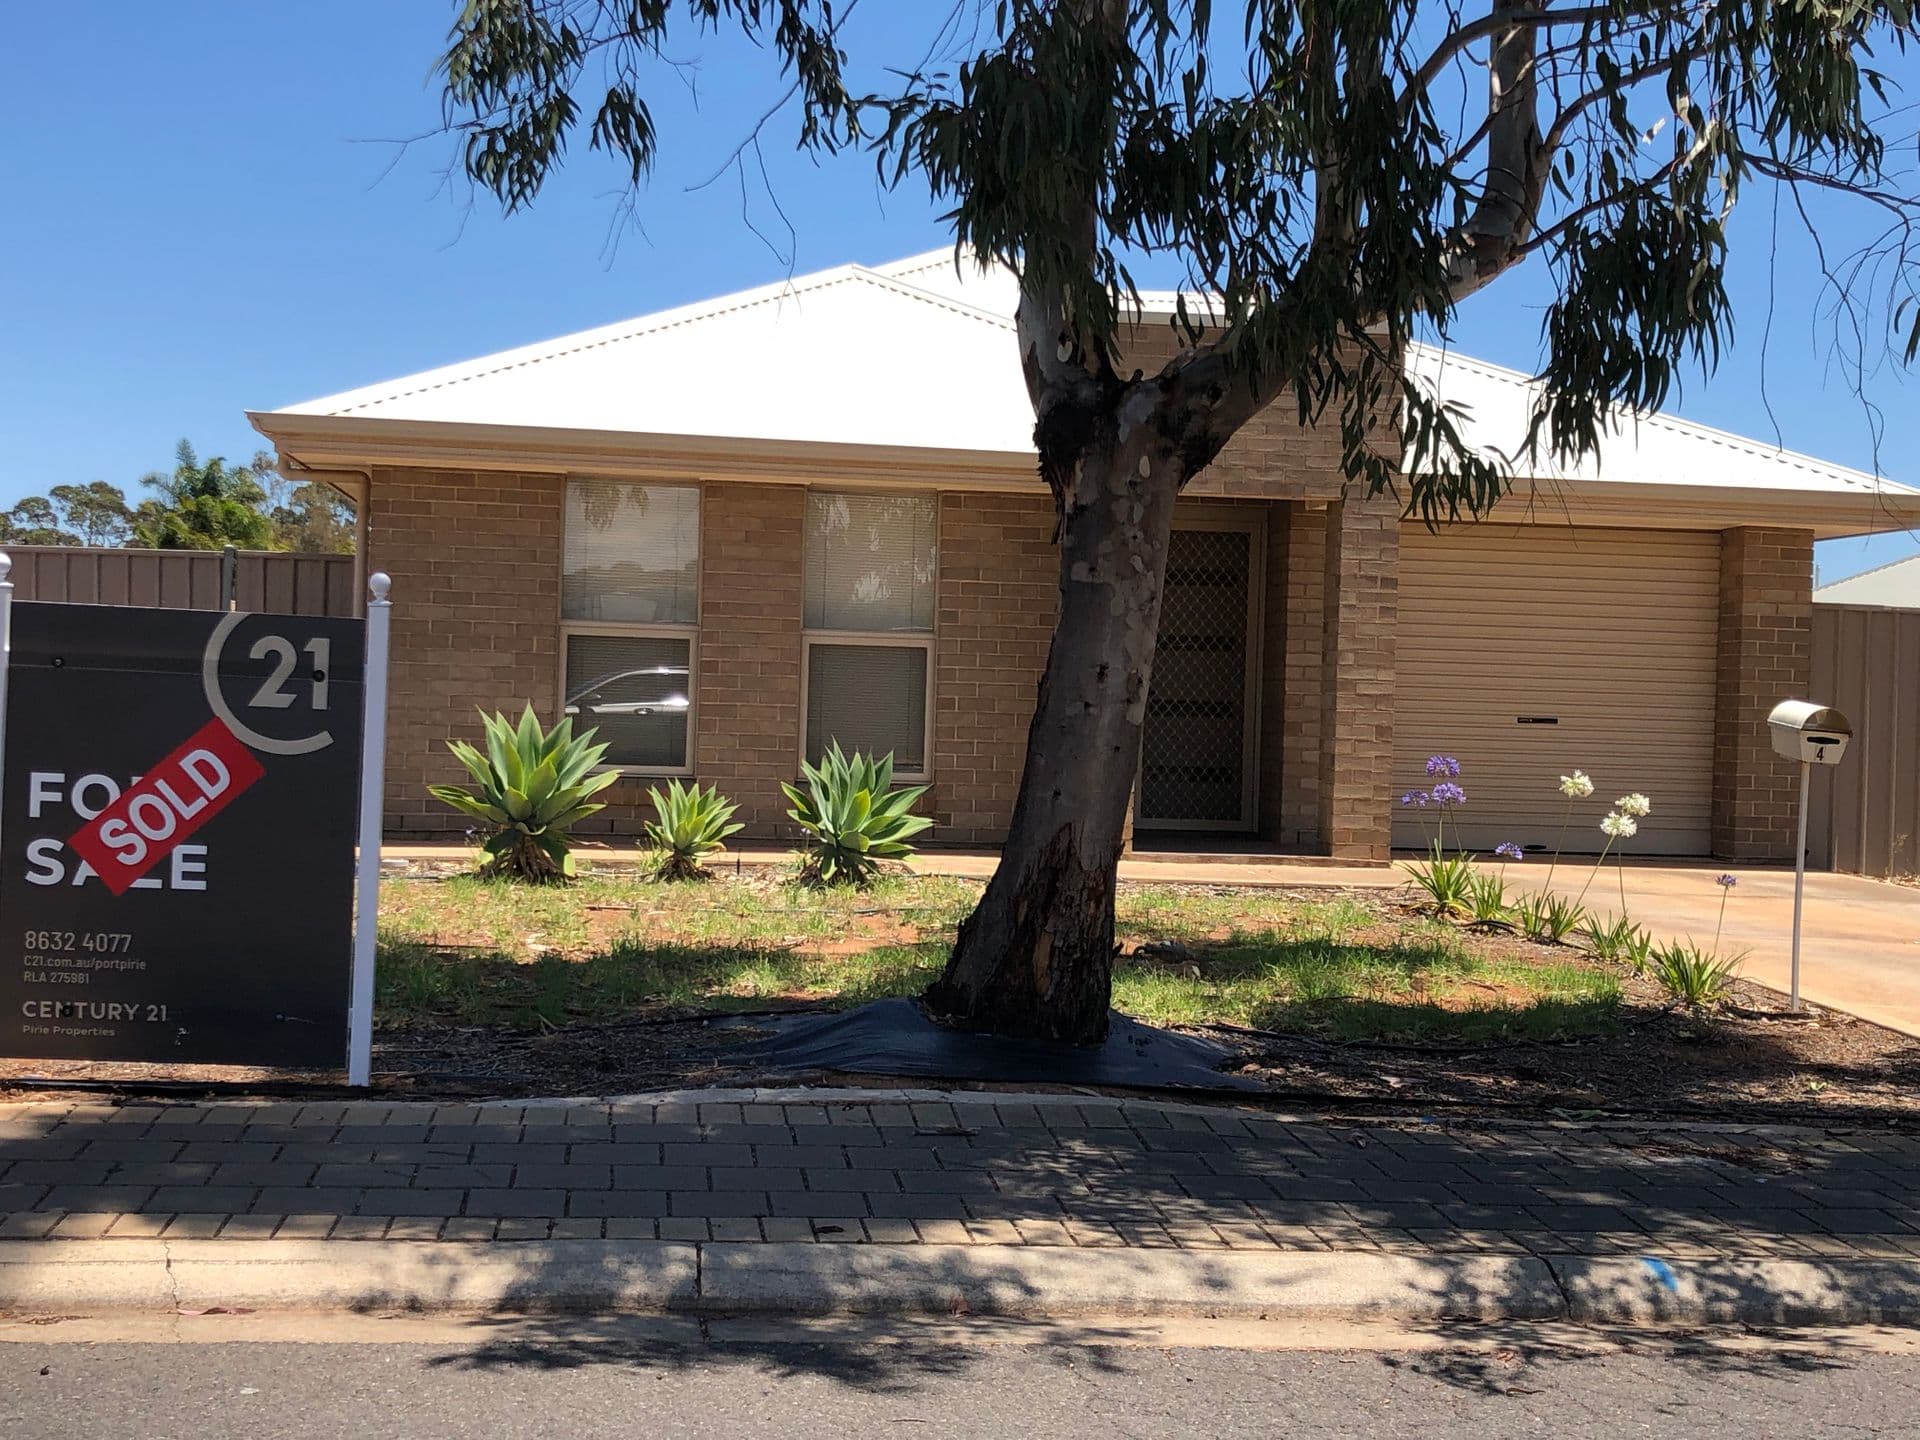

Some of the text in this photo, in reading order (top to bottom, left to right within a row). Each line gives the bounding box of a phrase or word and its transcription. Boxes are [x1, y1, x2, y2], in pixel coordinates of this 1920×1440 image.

[248, 635, 330, 710] 21
[1816, 746, 1825, 761] 4
[29, 771, 144, 821] FO
[99, 749, 231, 866] SOLD
[25, 930, 132, 953] 8632 4077
[23, 955, 147, 971] C21.com.au/portpirie
[23, 971, 48, 983] RLA
[146, 1004, 168, 1022] 21
[22, 1025, 116, 1037] Pirie Properties
